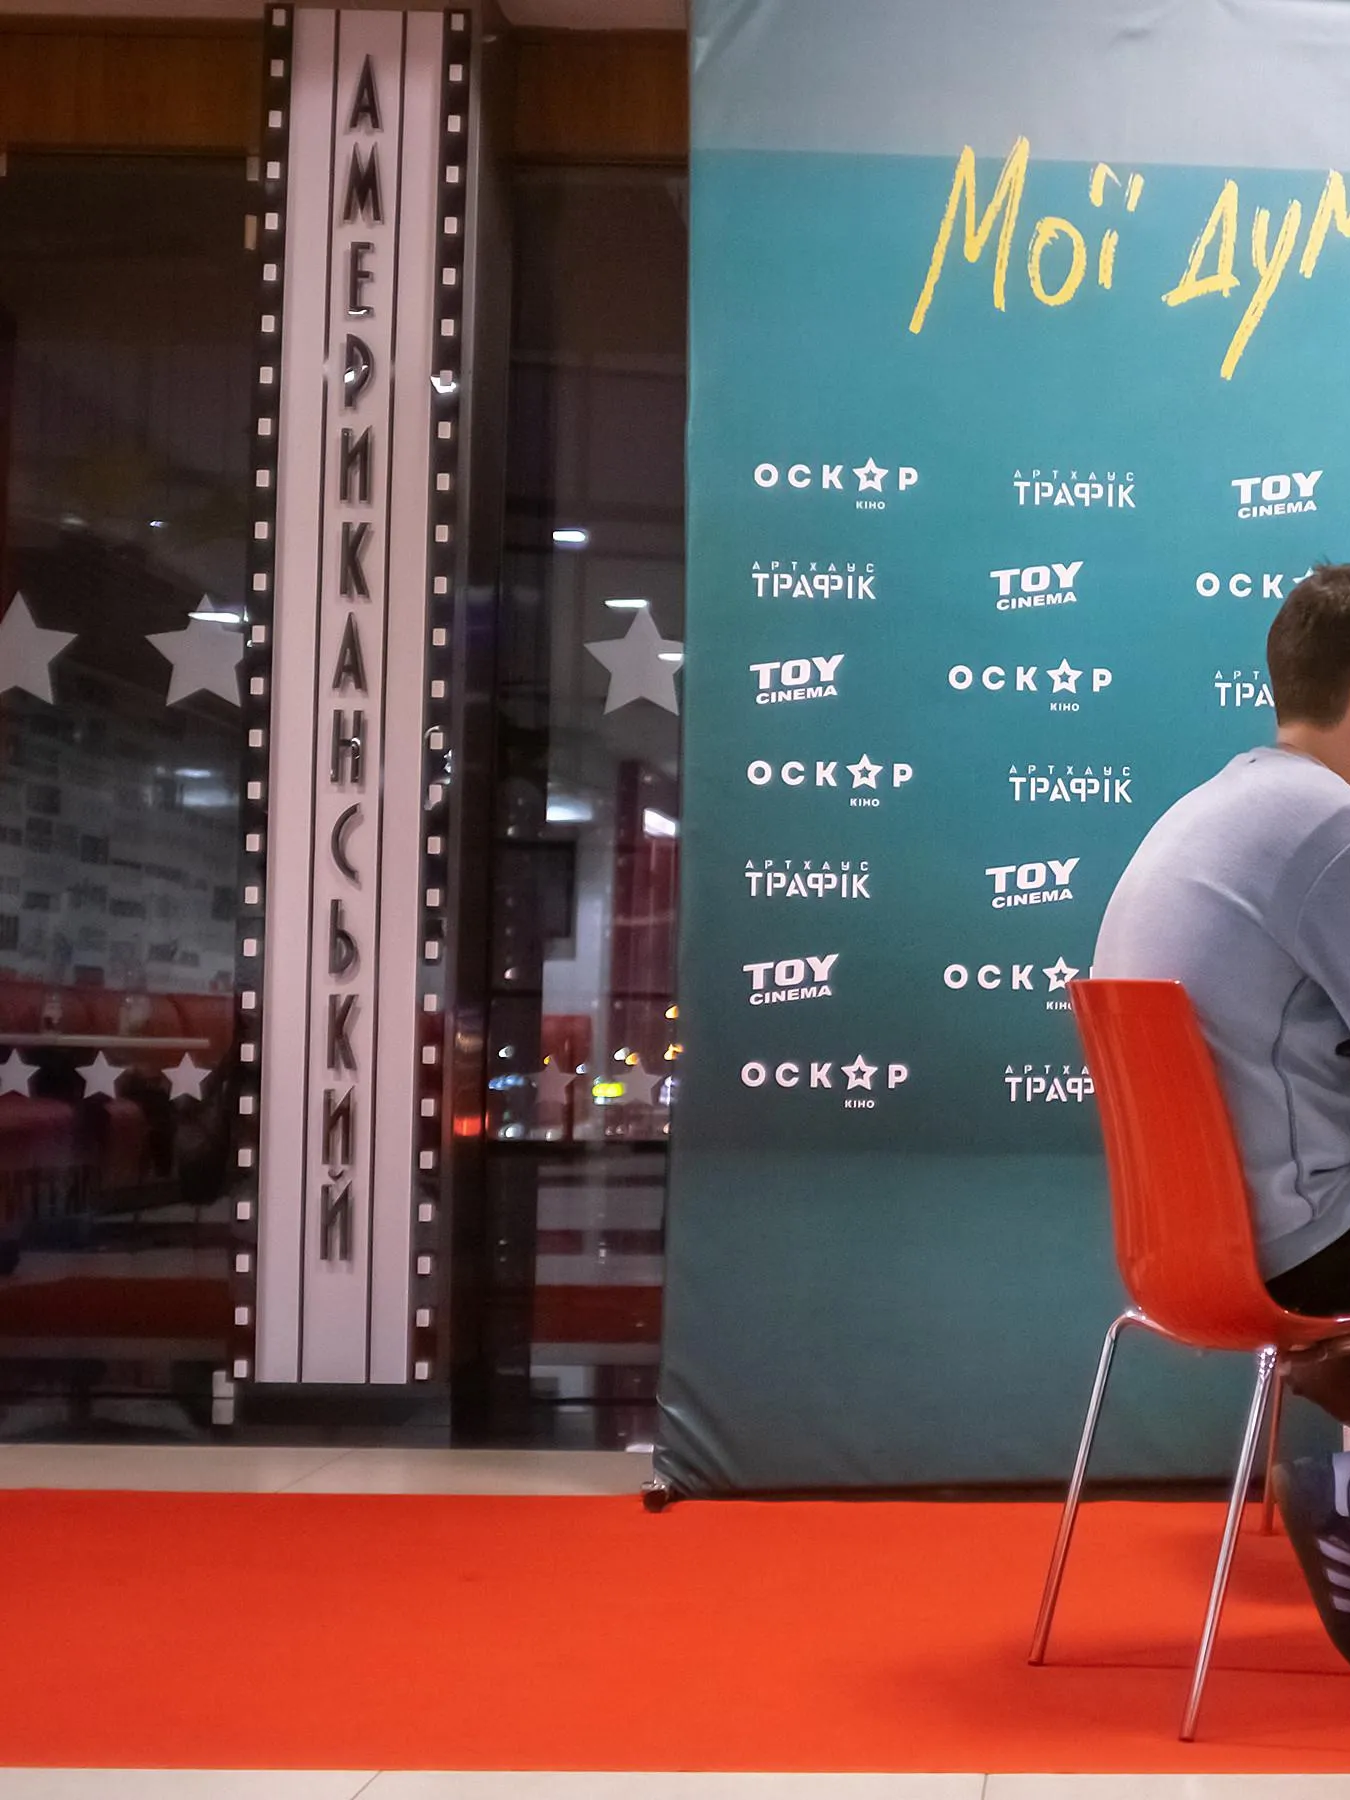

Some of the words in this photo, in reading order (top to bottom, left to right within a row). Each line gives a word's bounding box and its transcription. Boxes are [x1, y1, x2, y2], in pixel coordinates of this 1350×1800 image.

[1013, 480, 1136, 508] ТРАФІК
[1231, 471, 1323, 505] TOY
[855, 501, 886, 509] КІНО
[1237, 499, 1317, 518] CINEMA
[751, 572, 876, 599] ТРАФІК
[989, 561, 1084, 596] TOY
[996, 590, 1077, 610] CINEMA
[319, 54, 384, 1264] АМЕРИКАНСЬКИЙ
[749, 654, 845, 690] TOY
[755, 683, 838, 704] CINEMA
[1050, 703, 1080, 711] КІНО
[1008, 776, 1133, 803] ТРАФІК
[744, 871, 871, 898] ТРАФІК
[985, 858, 1080, 894] TOY
[991, 888, 1074, 908] CINEMA
[742, 954, 839, 990] TOY
[749, 984, 833, 1005] CINEMA
[1004, 1064, 1089, 1075] АРТХА
[1004, 1076, 1095, 1103] ТРАФ
[844, 1100, 875, 1108] КІНО
